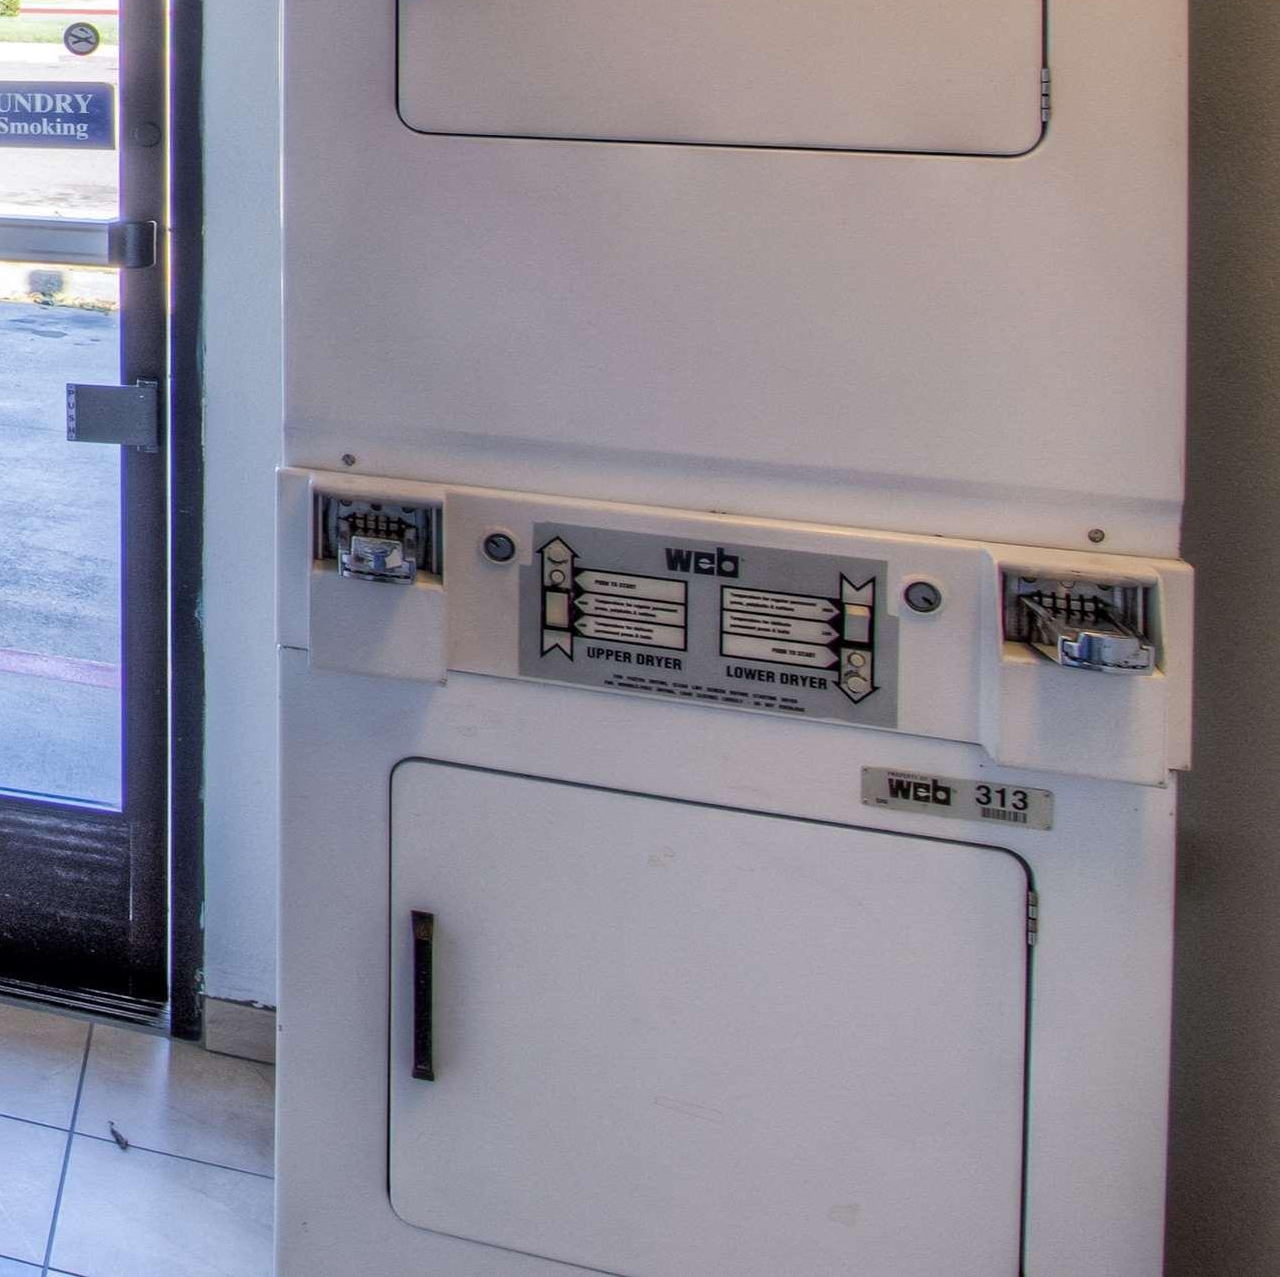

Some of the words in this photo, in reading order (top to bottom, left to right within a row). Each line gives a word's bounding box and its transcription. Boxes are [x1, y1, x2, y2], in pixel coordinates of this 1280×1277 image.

[586, 646, 632, 664] UPPER
[636, 653, 682, 671] DRYER
[726, 665, 776, 683] LOWER
[780, 672, 828, 690] DRYER
[974, 785, 1029, 811] 313
